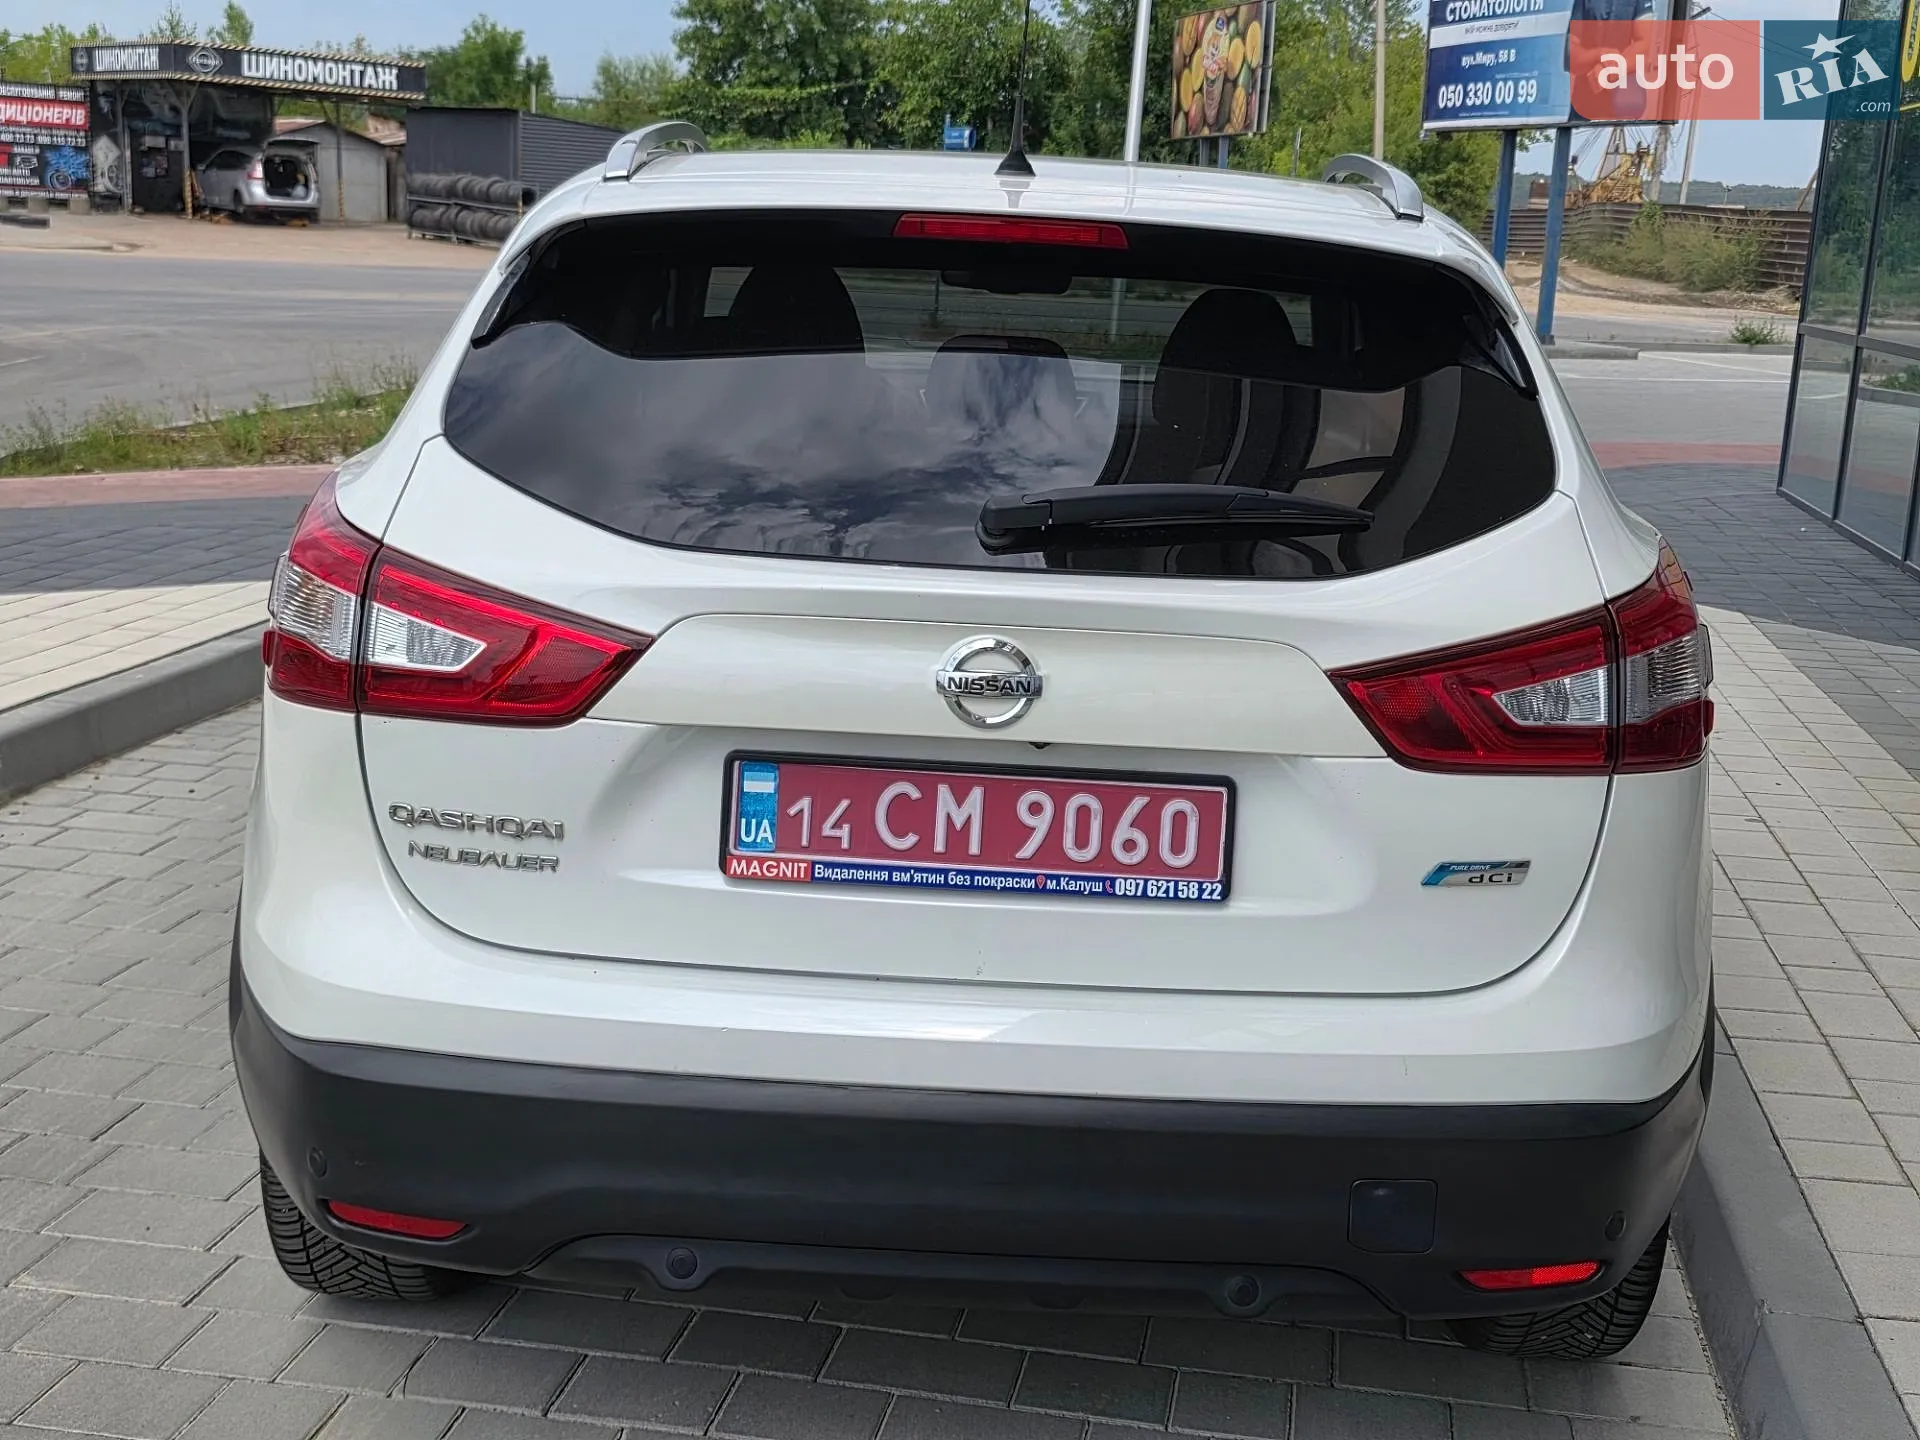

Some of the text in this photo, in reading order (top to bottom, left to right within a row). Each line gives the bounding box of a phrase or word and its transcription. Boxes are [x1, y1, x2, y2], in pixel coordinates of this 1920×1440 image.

[96, 45, 159, 72] ШИНОМОНТАЖ
[241, 52, 399, 91] ШИНОМОНТАЖ
[1438, 78, 1538, 109] 050 330 00 99
[946, 676, 1032, 694] NISSAN
[388, 802, 565, 841] QASHQAI
[740, 818, 774, 843] UA
[786, 781, 1200, 869] 14 CM 9060
[408, 840, 560, 873] NEUBAUER
[729, 858, 808, 879] MAGNIT
[814, 864, 1222, 900] Видалення вм'ятин без покраски м.Калуш 097 621 58 22
